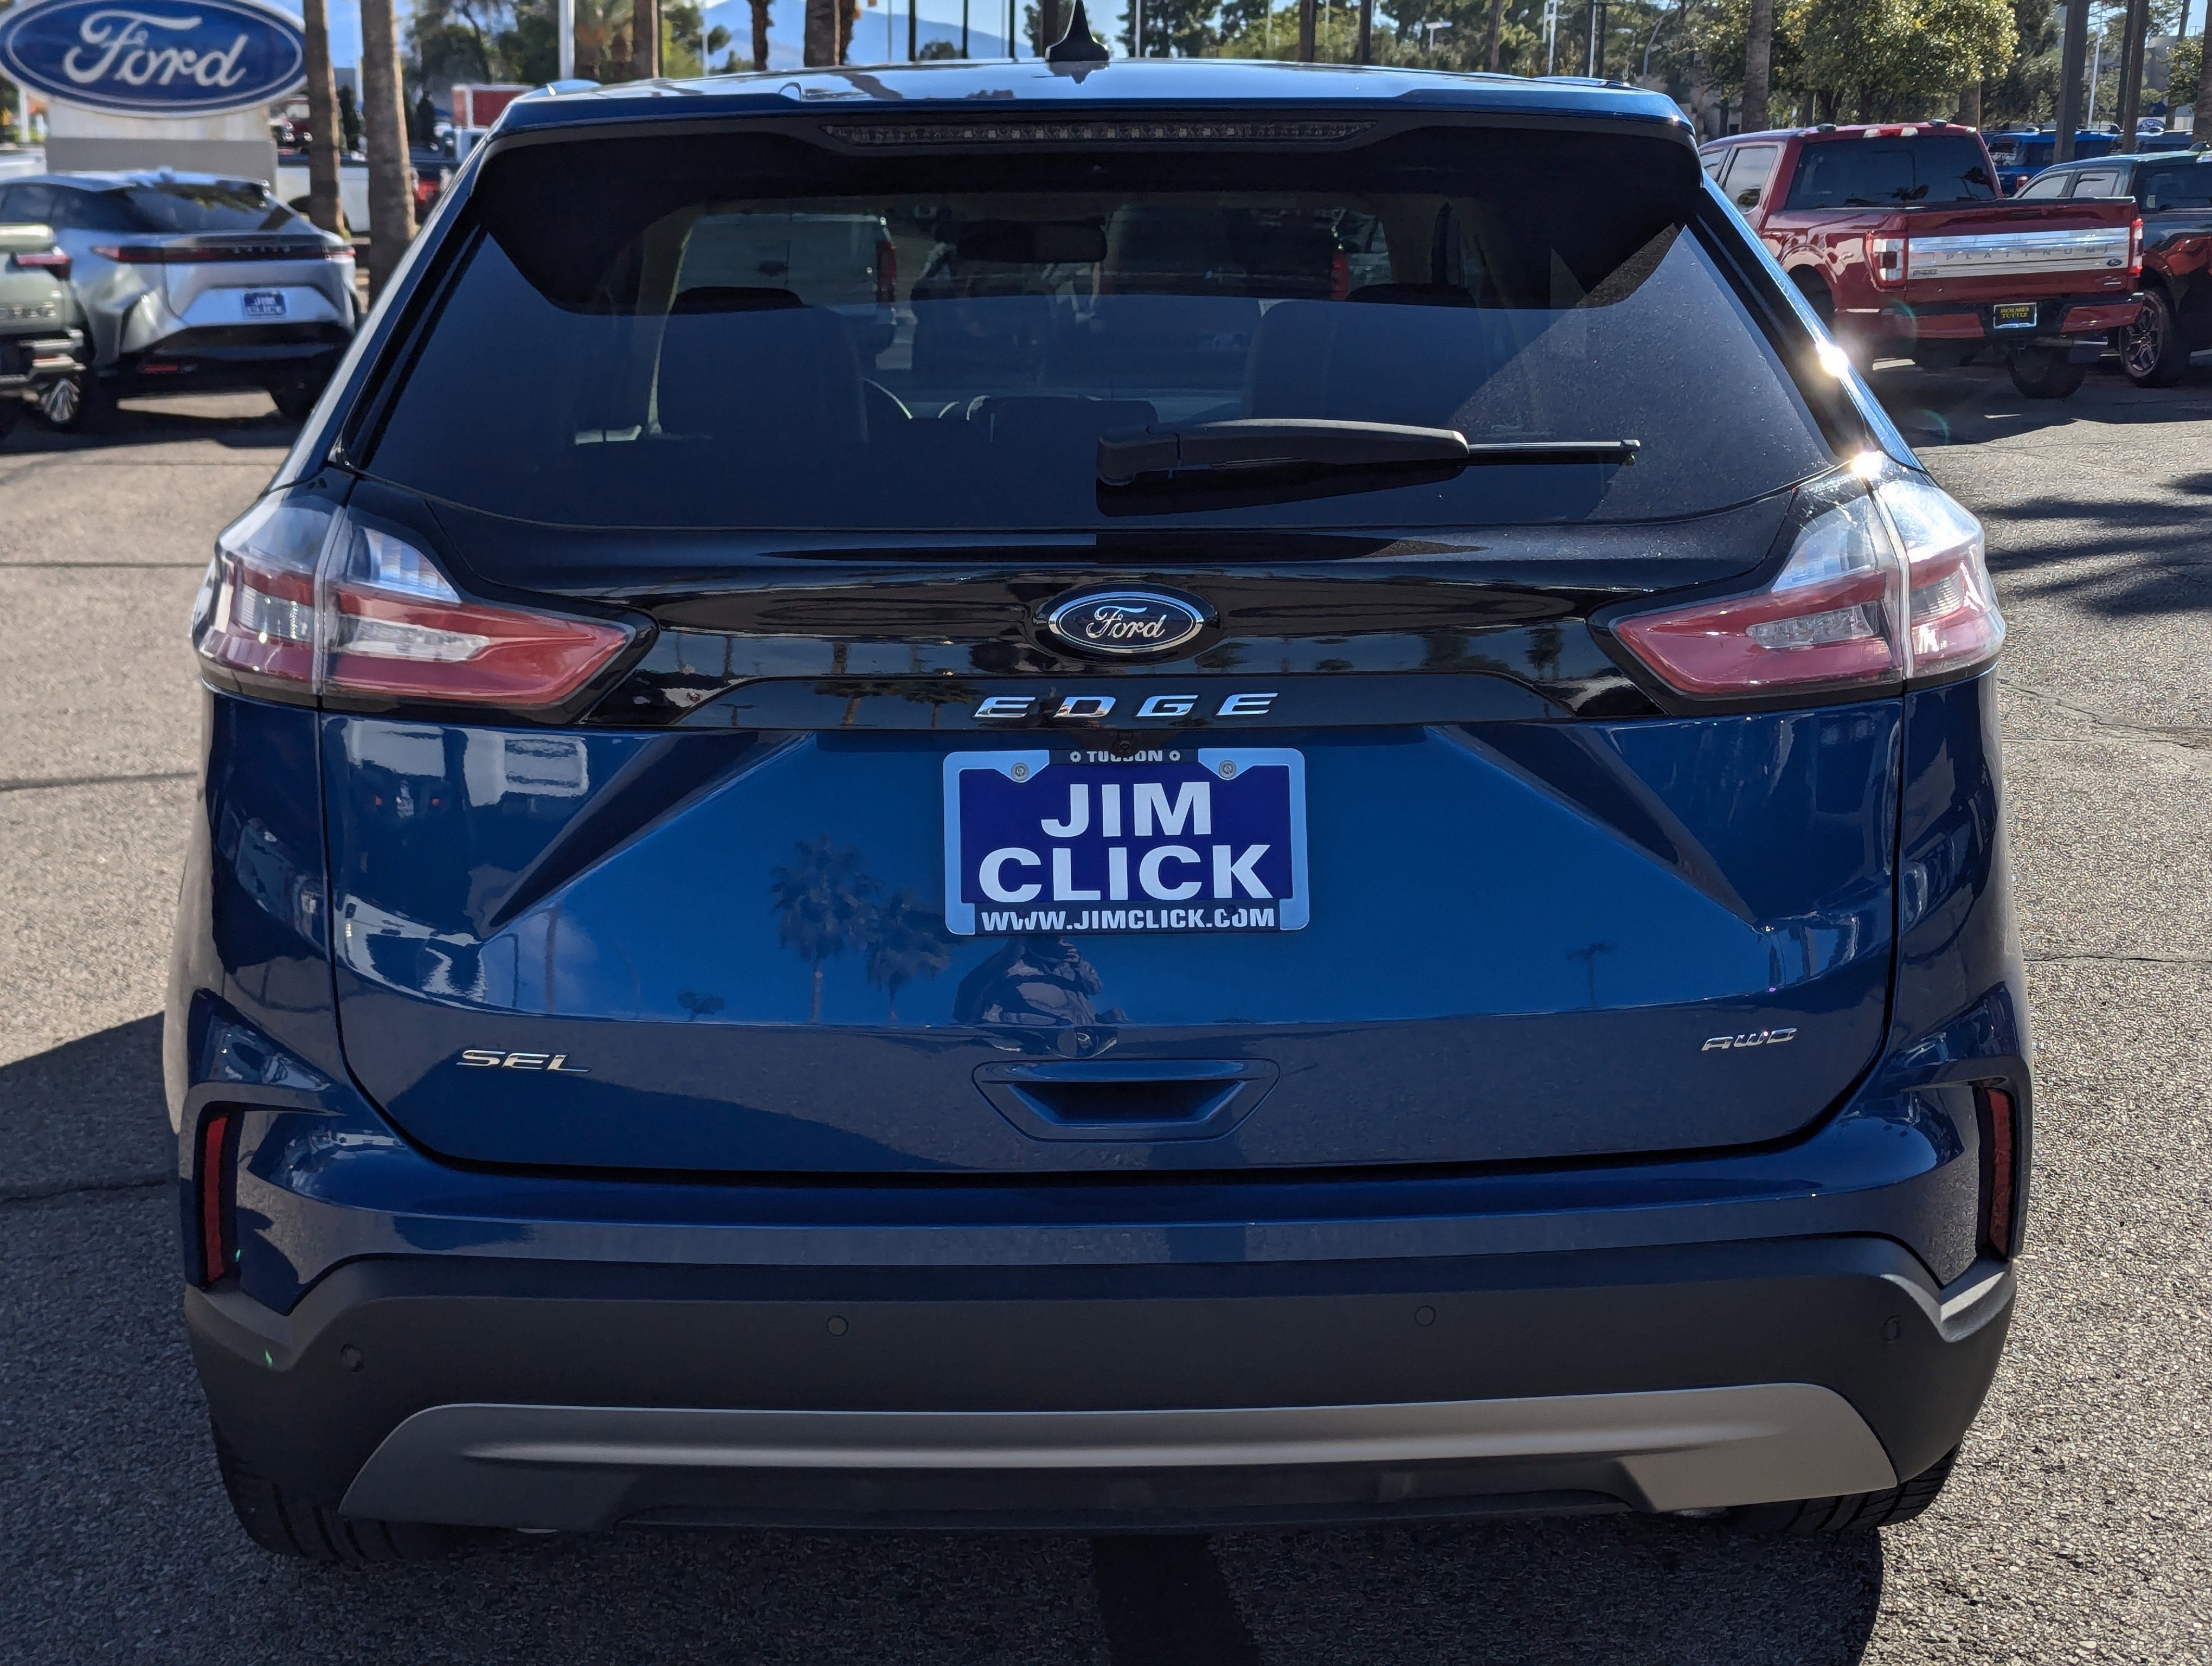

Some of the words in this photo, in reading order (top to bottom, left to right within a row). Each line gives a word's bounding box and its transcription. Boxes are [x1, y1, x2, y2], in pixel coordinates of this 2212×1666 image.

[63, 9, 249, 87] Ford
[1946, 246, 2096, 260] PLATINUM
[1085, 605, 1167, 639] Ford
[973, 693, 1278, 719] EDGE
[1040, 781, 1211, 838] JIM
[978, 844, 1274, 903] CLICK
[981, 907, 1275, 932] WWW.JIMCLICK.COM
[1701, 1027, 1797, 1052] AWD
[456, 1049, 590, 1072] SEL
